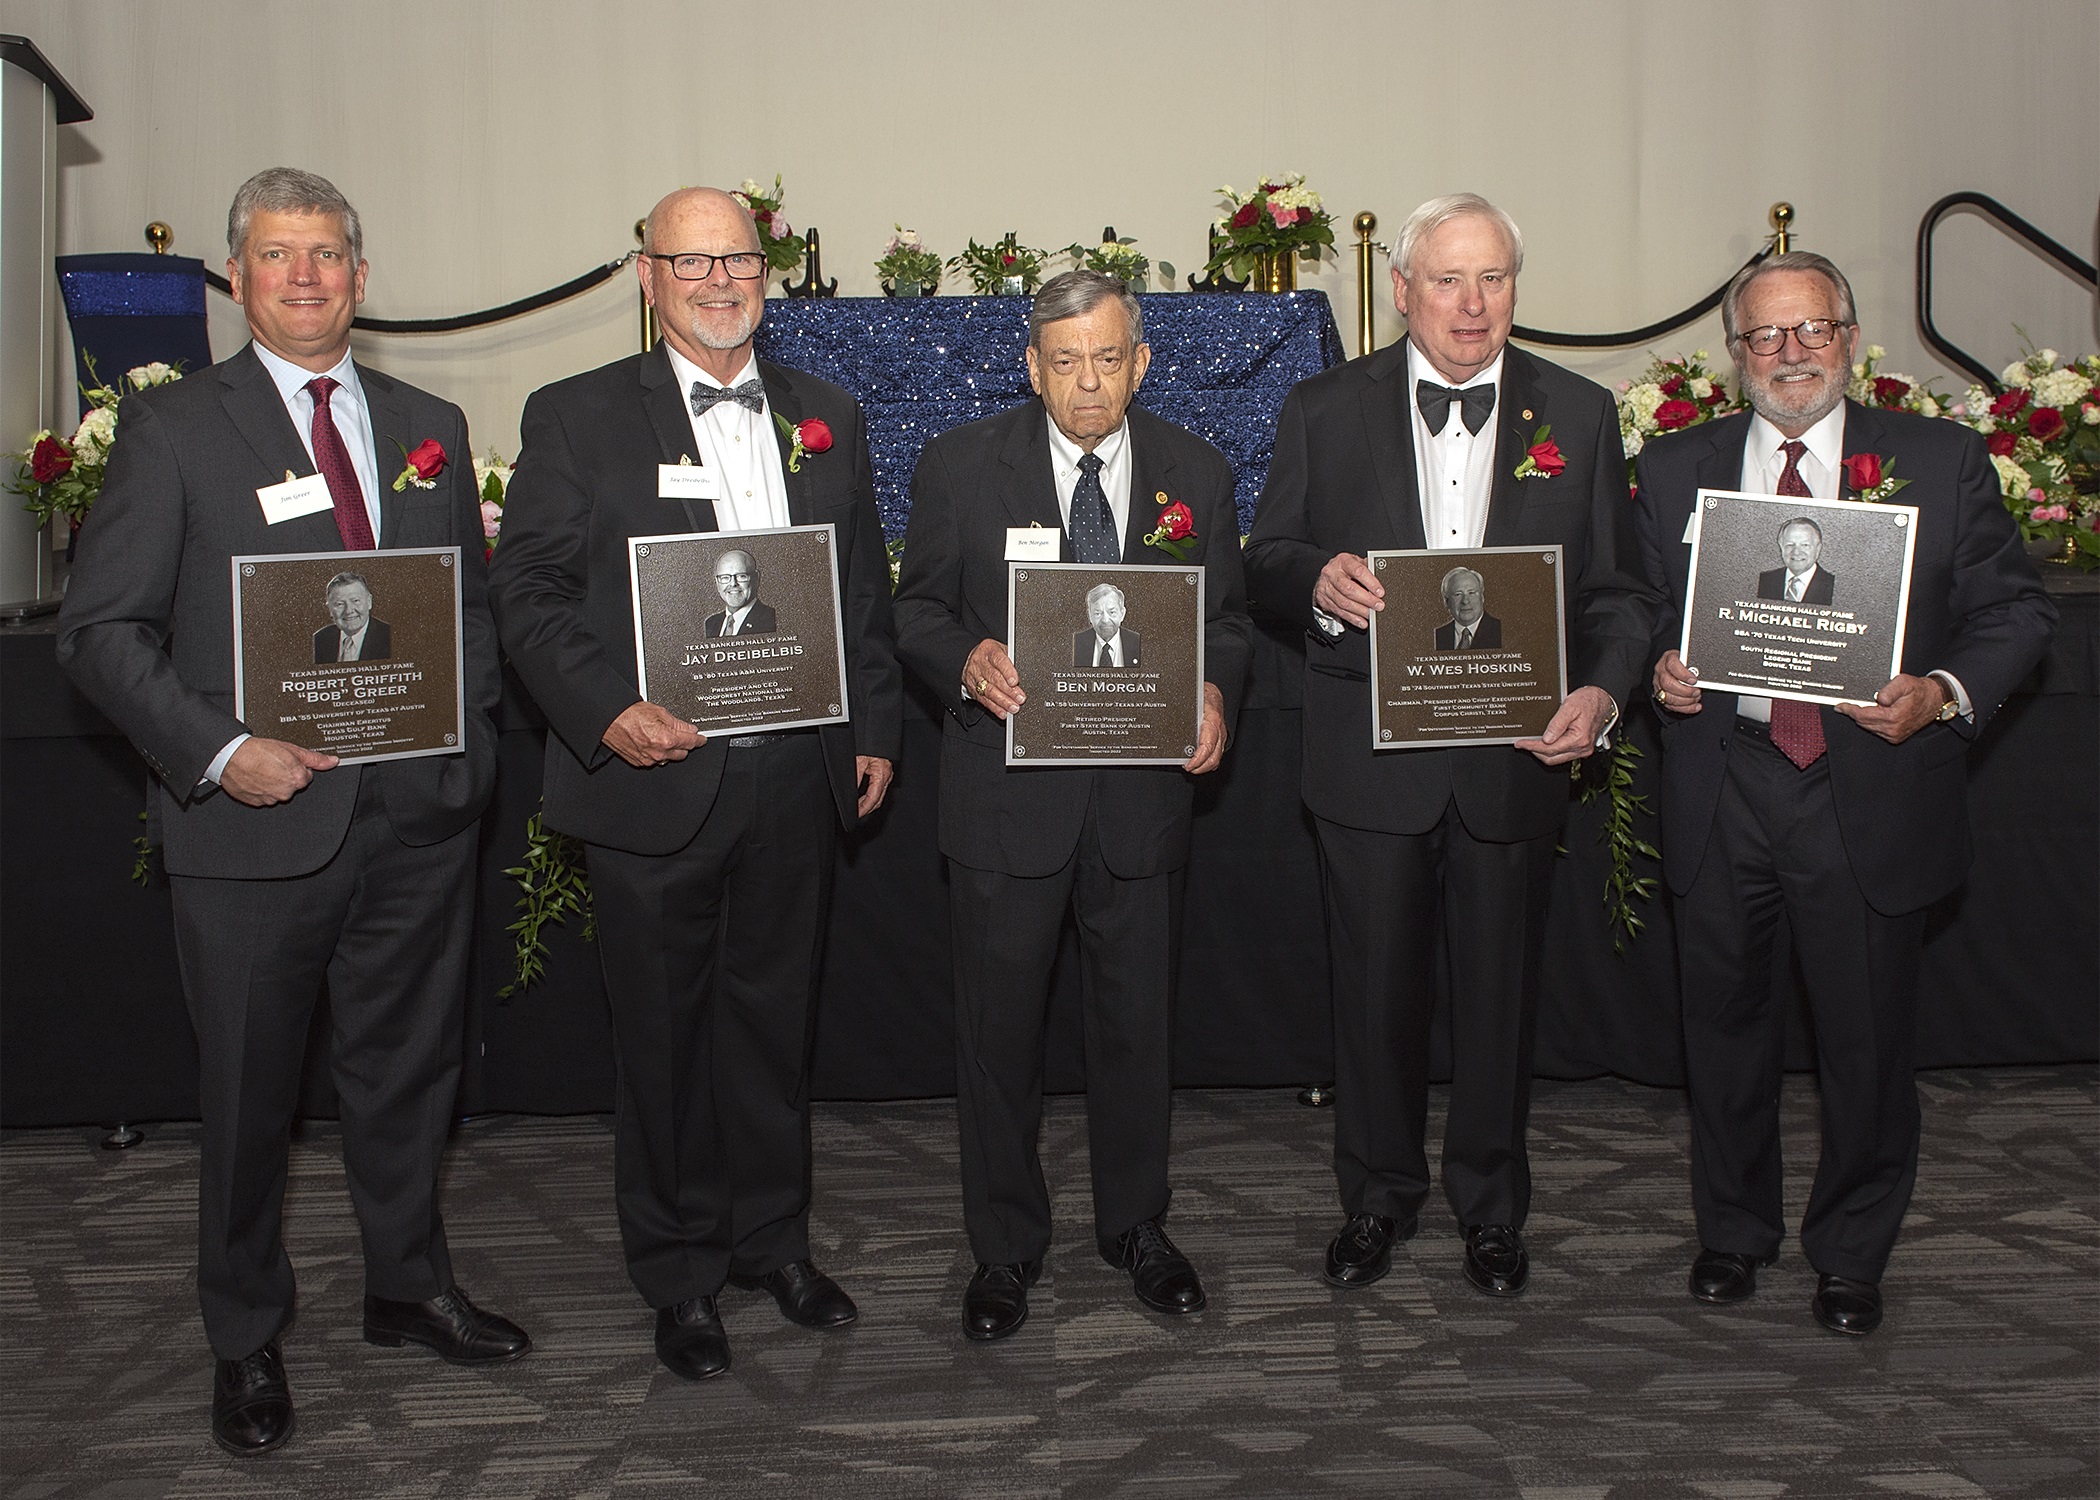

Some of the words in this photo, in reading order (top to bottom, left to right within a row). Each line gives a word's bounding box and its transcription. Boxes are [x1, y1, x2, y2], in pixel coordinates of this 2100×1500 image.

[293, 491, 310, 499] Greer
[1735, 601, 1759, 609] TEXAS
[1760, 604, 1796, 613] BANKERS
[1798, 607, 1818, 615] HALL
[1832, 611, 1854, 619] FAME
[1719, 608, 1734, 620] R.
[1739, 610, 1812, 629] MICHAEL
[1816, 619, 1868, 635] RIGBY
[711, 640, 744, 648] BANKERS
[1764, 633, 1785, 641] TEXAS
[1807, 638, 1847, 648] UNIVERSITY
[682, 653, 709, 666] JAY
[715, 646, 803, 663] DREIBELBIS
[1764, 648, 1798, 657] REGIONAL
[1800, 652, 1837, 662] PRESIDENT
[319, 667, 356, 675] BANKERS
[757, 666, 793, 674] UNIVERSITY
[1407, 665, 1424, 676] W.
[1430, 664, 1462, 675] WES
[1468, 663, 1532, 674] HOSKINS
[1763, 661, 1787, 669] BOWIE,
[1789, 664, 1811, 672] TEXAS
[282, 677, 346, 692] ROBERT
[352, 672, 422, 686] GRIFFITH
[1057, 682, 1087, 692] BEN
[1093, 682, 1156, 692] MORGAN
[712, 684, 746, 692] PRESIDENT
[299, 690, 348, 704] "BOB"
[354, 686, 407, 699] GREER
[697, 692, 741, 701] WOODFOREST
[743, 689, 773, 697] NATIONAL
[333, 699, 375, 708] (DECEASED)
[721, 697, 763, 706] WOODLANDS,
[312, 710, 354, 719] UNIVERSITY
[317, 721, 355, 729] CHAIRMAN
[357, 718, 391, 726] EMERITUS
[325, 734, 360, 742] HOUSTON,
